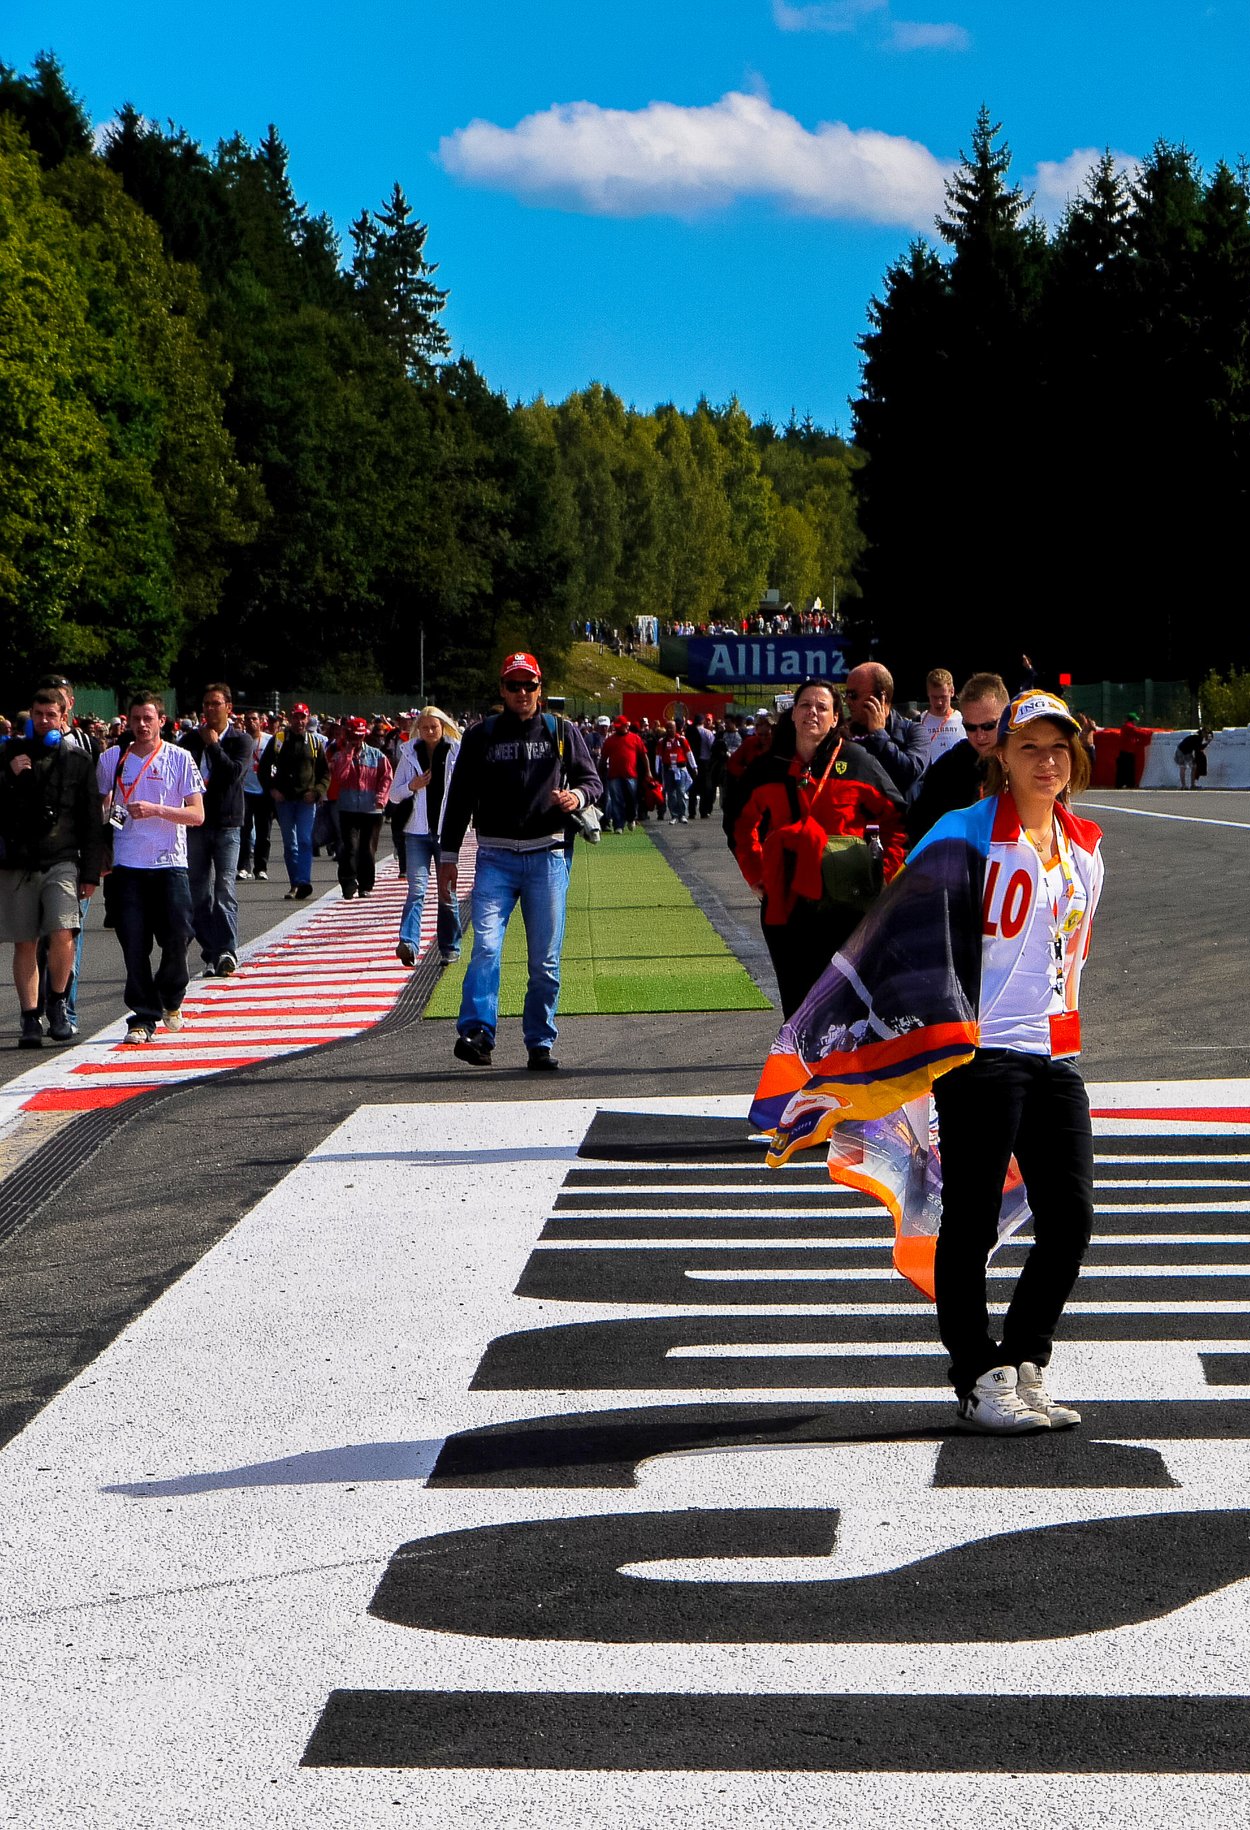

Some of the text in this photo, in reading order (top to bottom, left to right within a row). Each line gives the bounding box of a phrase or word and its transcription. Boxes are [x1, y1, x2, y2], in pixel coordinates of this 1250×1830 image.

[709, 644, 848, 676] Allianz
[1018, 700, 1046, 715] ING
[524, 740, 555, 760] YEAR
